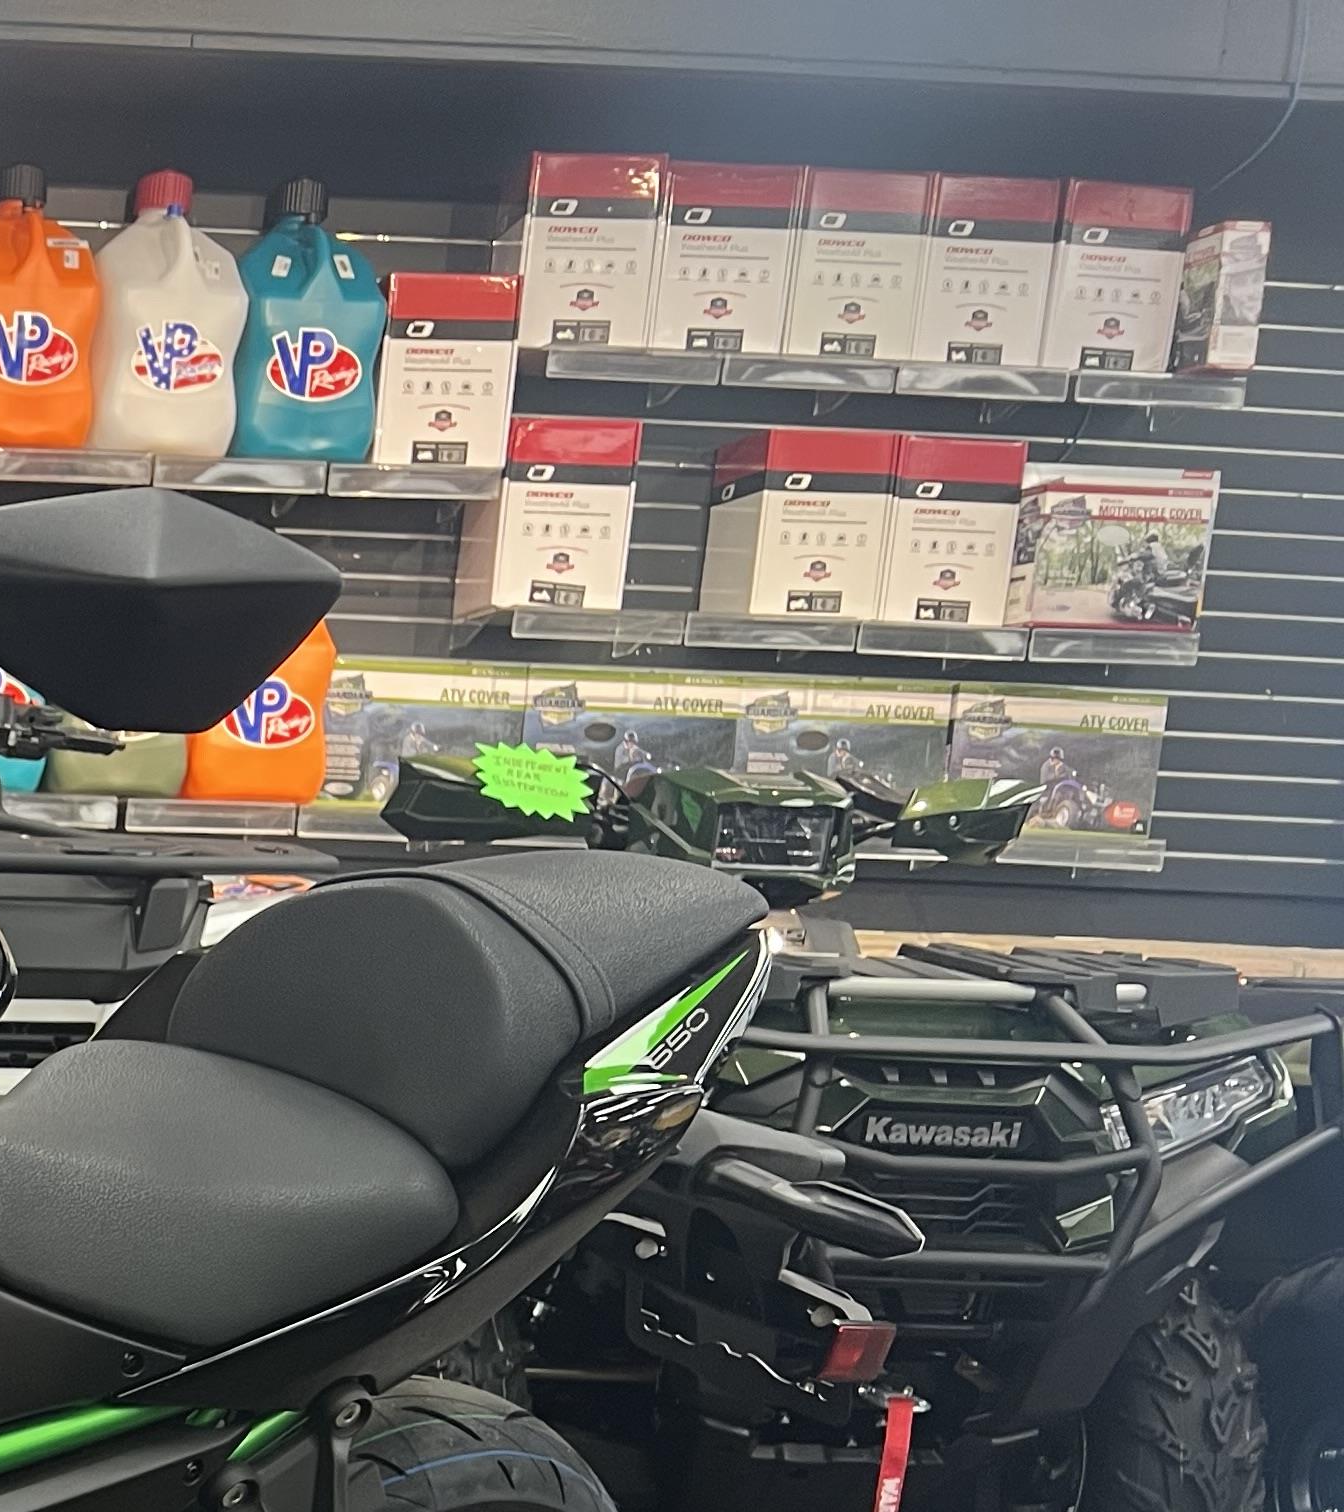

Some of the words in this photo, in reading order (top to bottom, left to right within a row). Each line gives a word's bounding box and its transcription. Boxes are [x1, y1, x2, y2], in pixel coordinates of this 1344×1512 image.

[138, 321, 199, 390] VP
[274, 329, 336, 398] VP
[440, 688, 466, 704] ATV
[469, 689, 510, 705] COVER
[653, 696, 679, 712] ATV
[682, 698, 723, 713] COVER
[865, 704, 891, 719] ATV
[894, 705, 935, 720] COVER
[1080, 714, 1105, 729] ATV
[1108, 716, 1150, 731] COVER
[649, 1007, 710, 1071] 650
[865, 1116, 1023, 1149] Kawasaki
